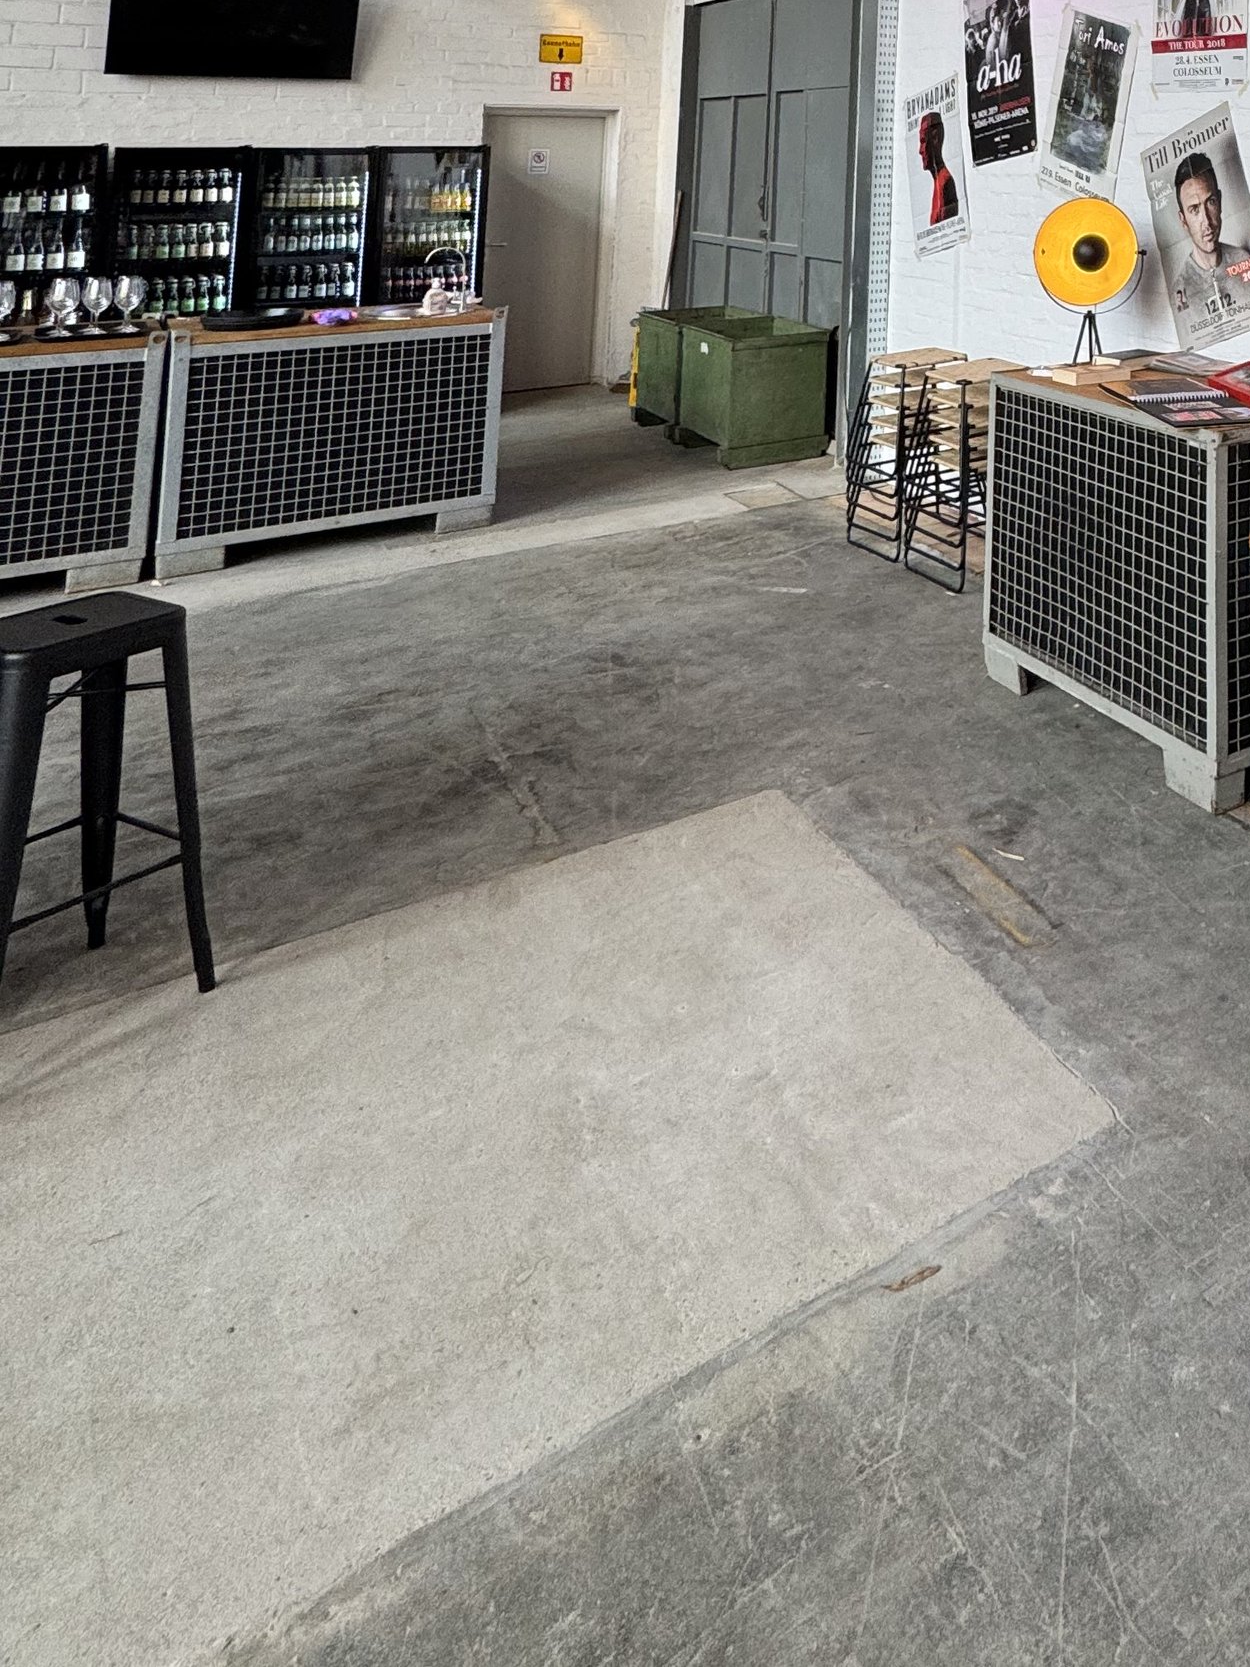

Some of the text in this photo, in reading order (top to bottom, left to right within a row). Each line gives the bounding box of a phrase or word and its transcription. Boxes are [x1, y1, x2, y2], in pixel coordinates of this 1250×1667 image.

[1074, 19, 1125, 56] Tori Amos
[1155, 13, 1245, 39] EVOLUTION
[1168, 39, 1226, 51] THE TOUR 2018
[976, 47, 1023, 93] a-ha
[1193, 54, 1220, 64] ESSEN
[1172, 65, 1222, 78] COLOSSEUM
[1145, 116, 1229, 174] Till Brönner
[1054, 171, 1073, 188] Essen
[1190, 311, 1224, 334] DÜSSELDORF
